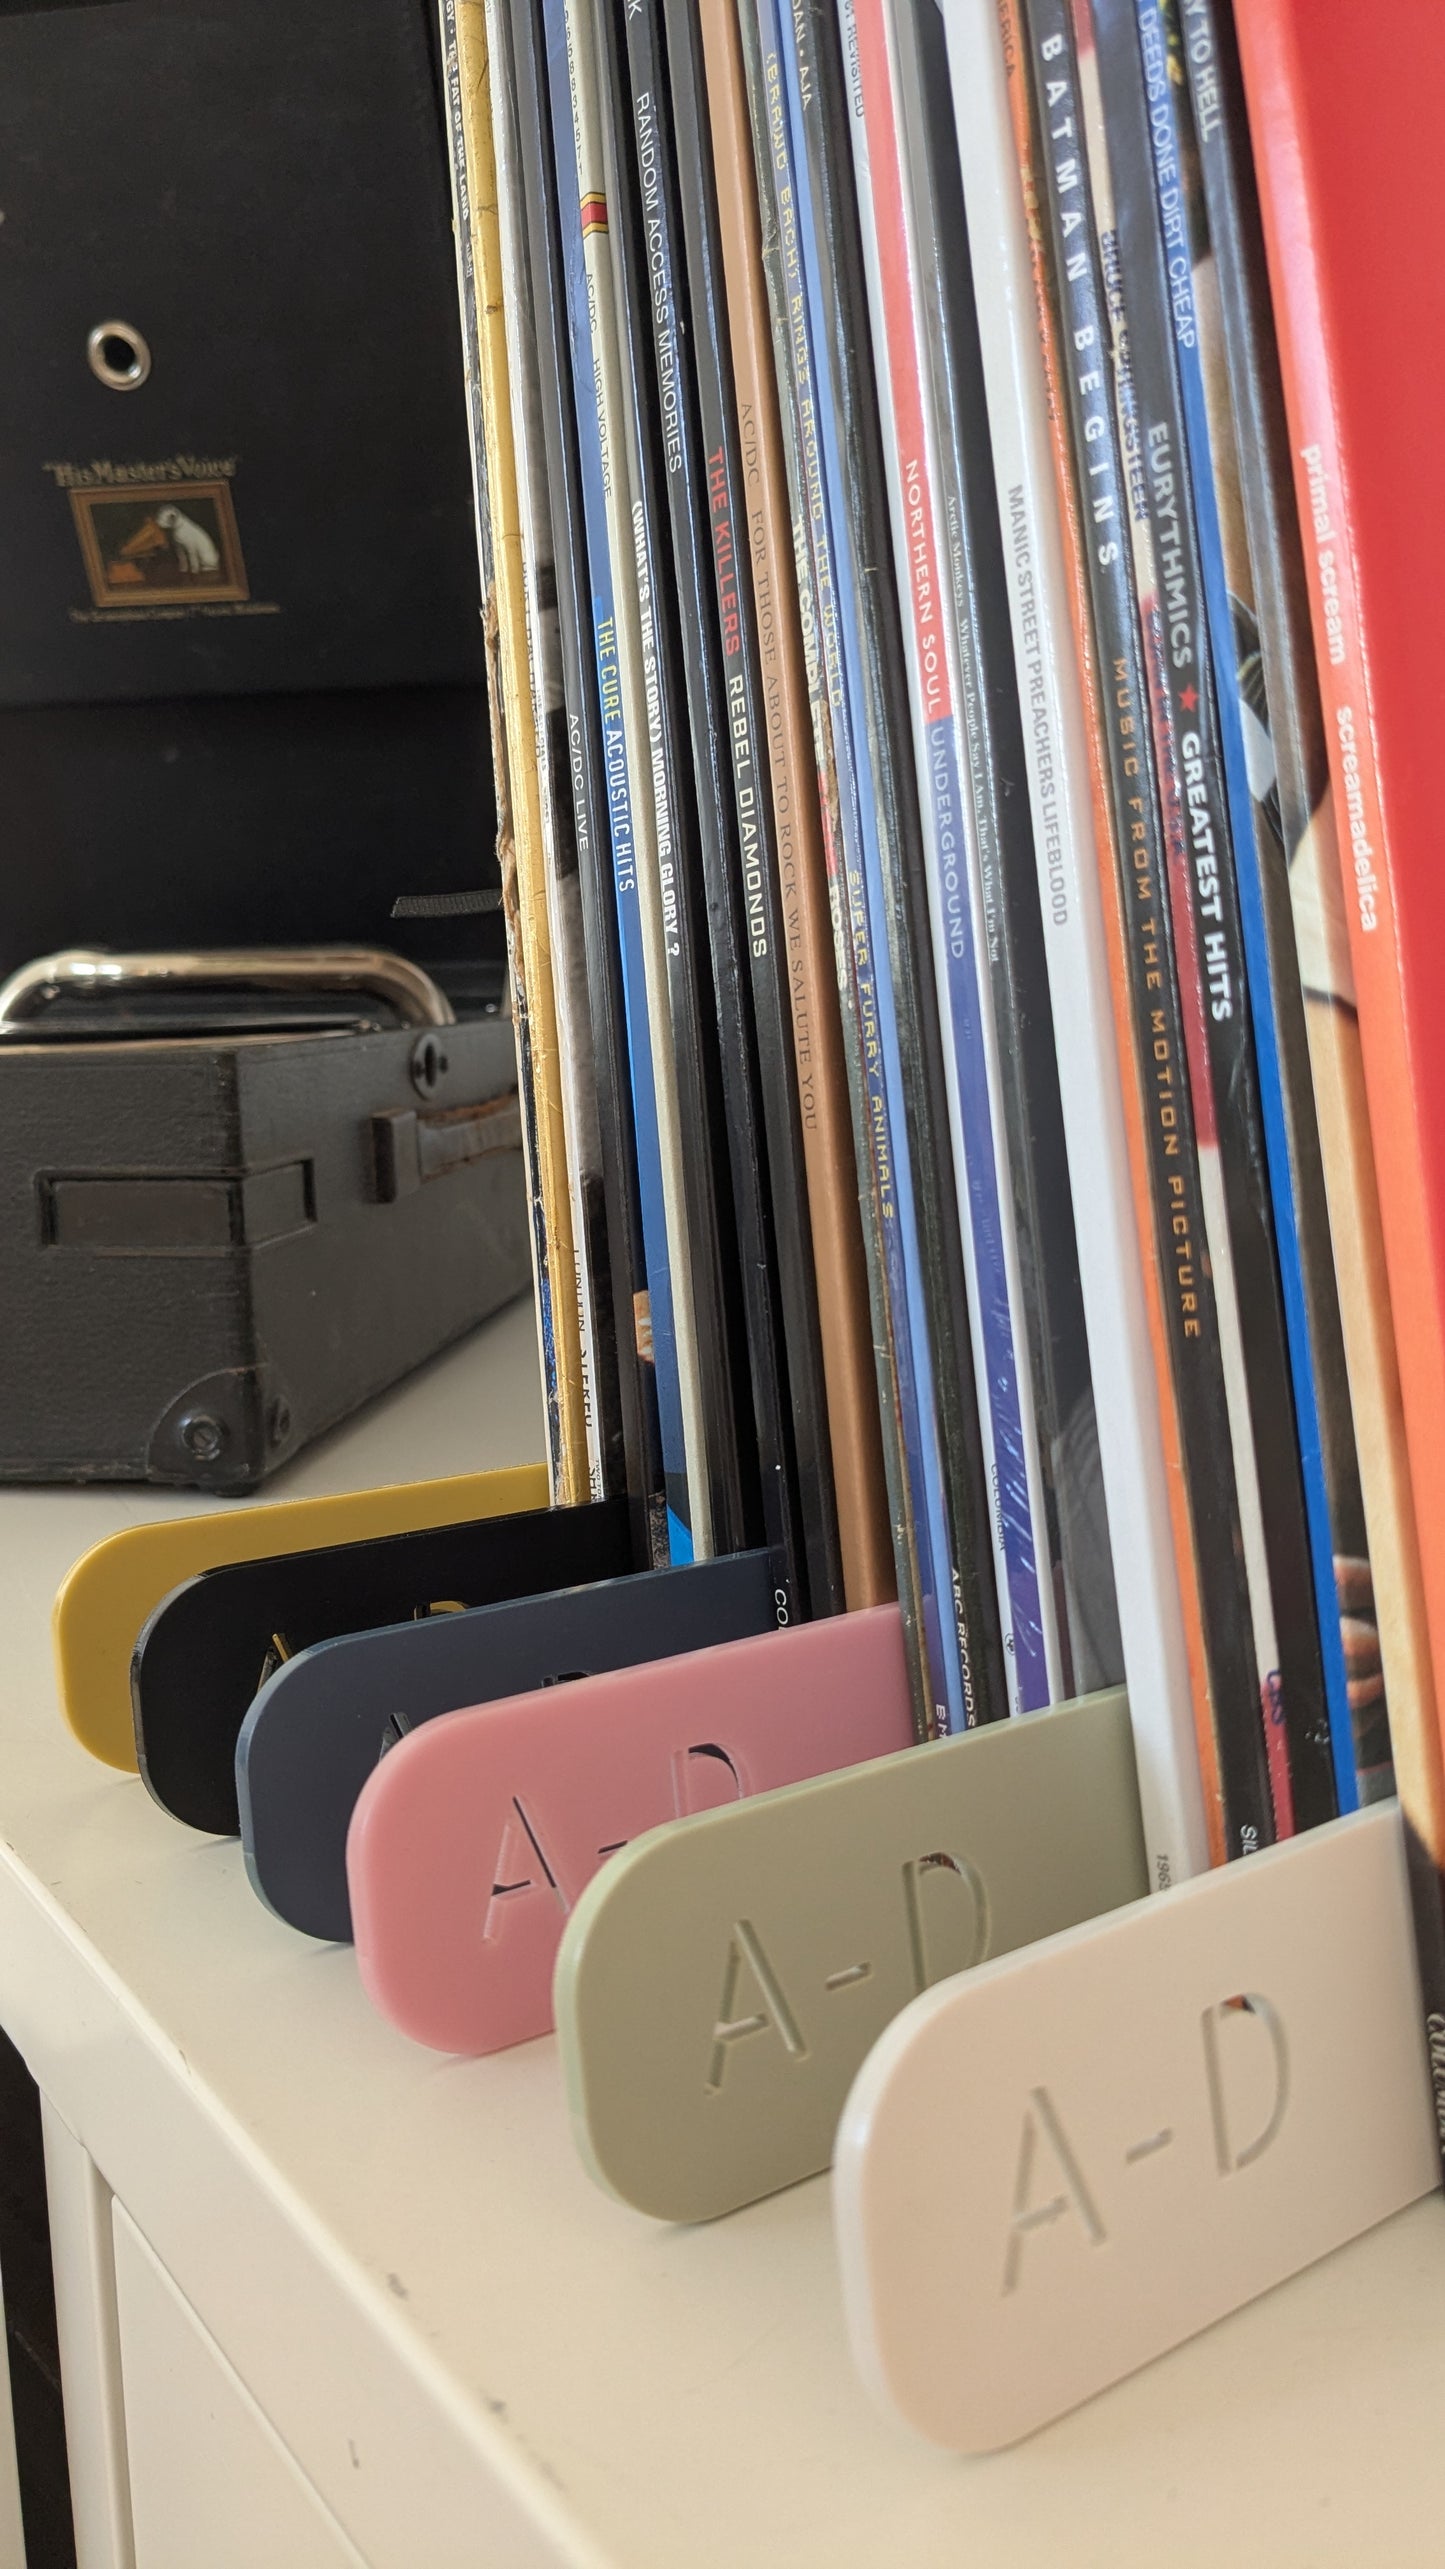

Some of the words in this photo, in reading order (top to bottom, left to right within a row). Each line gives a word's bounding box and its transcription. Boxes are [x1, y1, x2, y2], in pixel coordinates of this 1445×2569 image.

[1139, 11, 1164, 102] DEEDS
[1190, 24, 1212, 64] TO
[450, 78, 461, 107] FAT
[454, 113, 464, 131] OF
[799, 66, 812, 111] AJA
[1198, 66, 1222, 142] HELL
[456, 136, 467, 169] THE
[636, 92, 662, 213] RANDOM
[1151, 104, 1177, 183] DONE
[459, 174, 469, 221] LAND
[1160, 188, 1184, 249] DIRT
[586, 273, 598, 334] AC/DC
[646, 218, 670, 323] ACCESS
[1040, 33, 1088, 281] BATMAN
[1073, 325, 1119, 567] BEGINS
[1169, 254, 1197, 349] CHEAP
[593, 357, 605, 407] HIGH
[656, 328, 683, 474] MEMORIES
[597, 410, 613, 498] VOLTAGE
[707, 446, 728, 513] THE
[741, 404, 760, 485] AC/DC
[752, 510, 767, 565] FOR
[791, 295, 811, 384] RINGS
[801, 399, 823, 520] AROUND
[817, 534, 830, 591] THE
[824, 604, 842, 707] WORLD
[946, 495, 960, 538] Arctic
[1006, 485, 1031, 568] MANIC
[631, 500, 652, 602] (WHAT'S
[713, 519, 742, 658] KILLERS
[906, 459, 933, 624] NORTHERN
[922, 634, 940, 714] SOUL
[949, 541, 966, 607] Monkeys
[597, 616, 615, 661] THE
[639, 606, 655, 651] THE
[758, 571, 777, 665] THOSE
[1016, 570, 1042, 656] STREET
[958, 618, 974, 687] Whatever
[1300, 444, 1336, 544] primal
[1318, 550, 1347, 667] scream
[1335, 705, 1378, 933] screamadelica
[601, 665, 622, 725] CURE
[644, 655, 663, 743] STORY)
[728, 674, 754, 780] REBEL
[767, 676, 786, 768] ABOUT
[963, 692, 979, 739] People
[1025, 659, 1057, 798] PREACHERS
[1148, 421, 1192, 668] EURYTHMICS
[1180, 731, 1224, 926] GREATEST
[1204, 928, 1234, 1021] HITS
[569, 713, 584, 791] AC/DC
[606, 730, 630, 837] ACOUSTIC
[969, 742, 981, 768] Say
[576, 799, 589, 852] LIVE
[651, 747, 673, 857] MORNING
[776, 776, 790, 814] TO
[615, 842, 635, 893] HITS
[736, 788, 768, 958] DIAMONDS
[781, 823, 798, 898] ROCK
[930, 726, 965, 960] UNDERGROUND
[978, 816, 990, 862] That's
[1039, 802, 1070, 926] LIFEBLOOD
[982, 864, 994, 902] What
[986, 908, 997, 932] I'm
[786, 909, 801, 950] WE
[829, 884, 848, 992] ROSES
[988, 936, 999, 962] Not
[789, 959, 813, 1064] SALUTE
[1111, 658, 1138, 778] MUSIC
[1127, 796, 1151, 899] FROM
[1140, 922, 1161, 991] THE
[1151, 1009, 1178, 1157] MOTION
[1167, 1176, 1200, 1338] PICTURE
[849, 870, 868, 966] SUPER
[860, 982, 881, 1077] FURRY
[871, 1096, 895, 1220] ANIMALS
[800, 1073, 817, 1129] YOU
[951, 1568, 964, 1614] ARC
[957, 1622, 976, 1727] RECORDS
